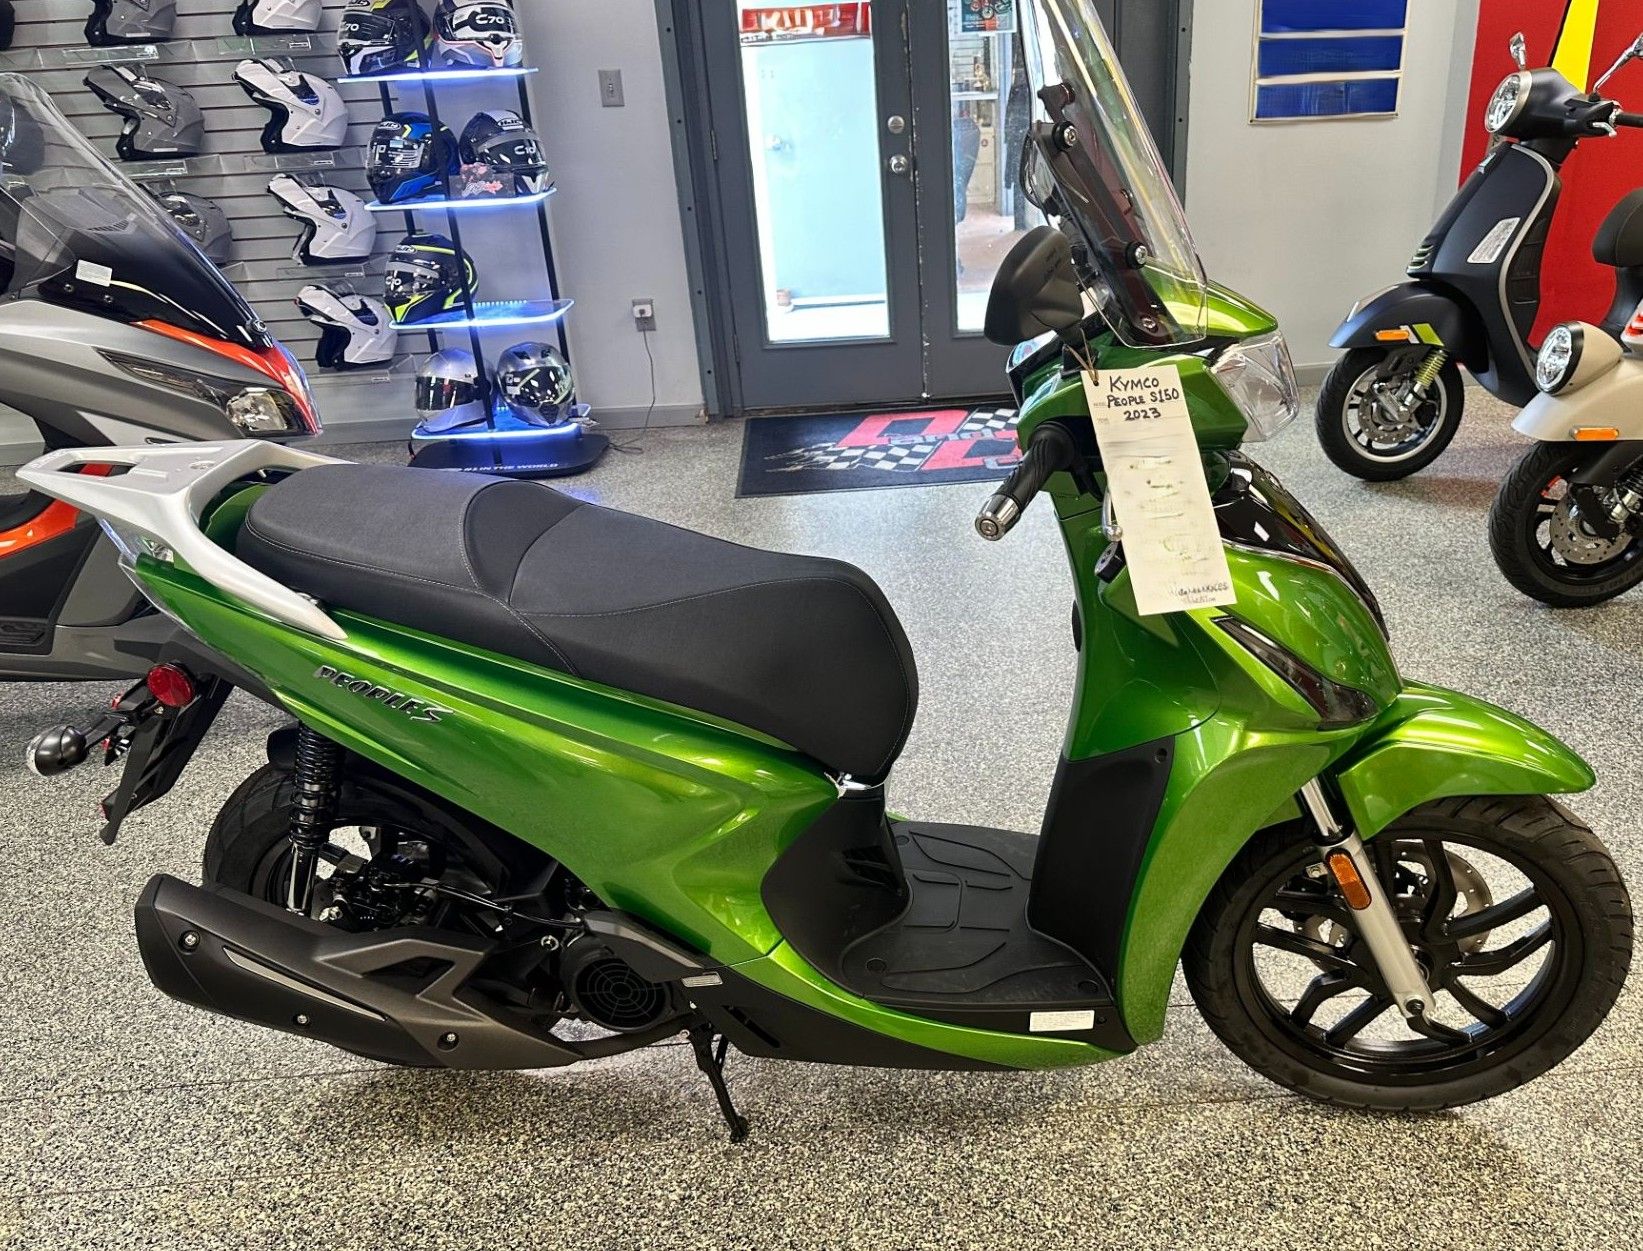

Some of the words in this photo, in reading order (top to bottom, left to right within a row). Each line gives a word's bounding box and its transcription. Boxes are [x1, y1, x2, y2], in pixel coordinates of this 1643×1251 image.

[475, 14, 505, 25] C70
[1109, 376, 1160, 392] KYMCO
[1107, 394, 1146, 408] PEOPLE
[1150, 388, 1179, 403] S150
[1123, 407, 1161, 421] 2023
